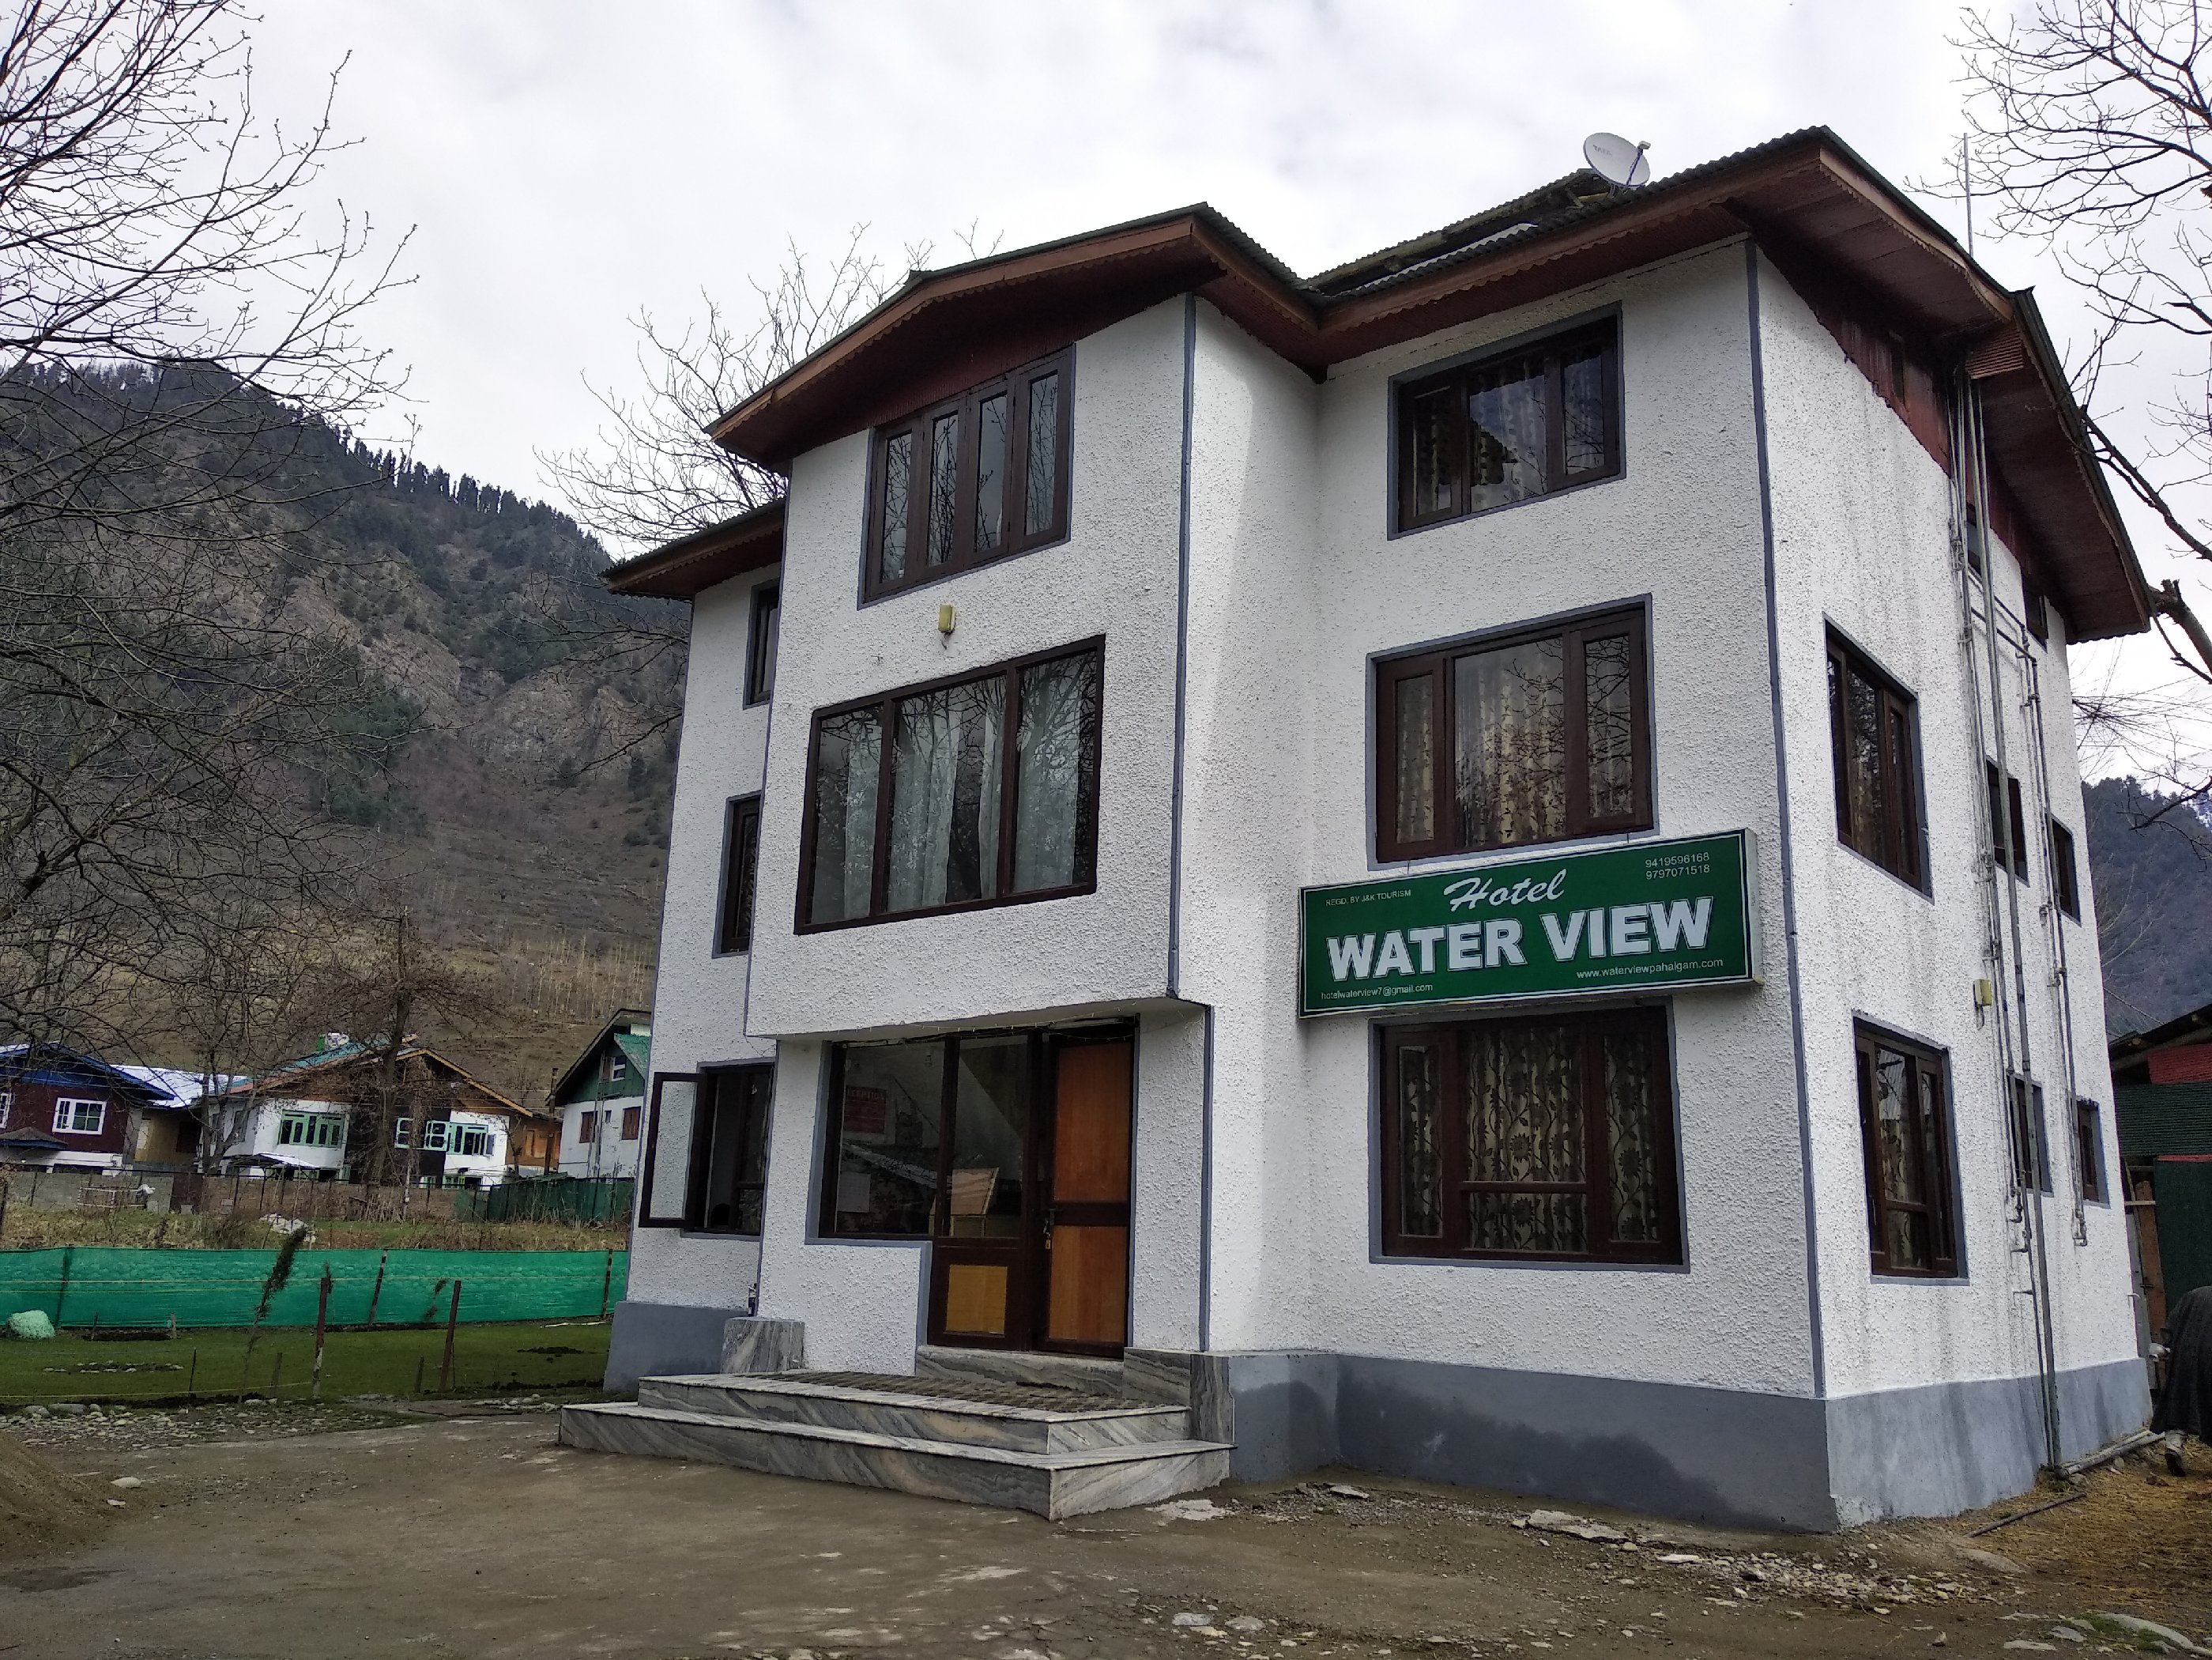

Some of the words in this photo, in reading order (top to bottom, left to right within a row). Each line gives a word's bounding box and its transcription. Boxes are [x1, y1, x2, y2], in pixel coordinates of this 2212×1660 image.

[1645, 852, 1709, 868] 9419596168
[1646, 864, 1710, 880] 9797071518
[1325, 897, 1348, 907] REGD.
[1377, 889, 1411, 900] TOURISM
[1443, 869, 1567, 911] Hotel
[1325, 917, 1528, 982] WATER
[1539, 896, 1714, 962] VIEW
[1576, 958, 1724, 979] www.waterviewpahalgam.com
[1321, 983, 1434, 1000] hotelwaterview7@gmail.com
